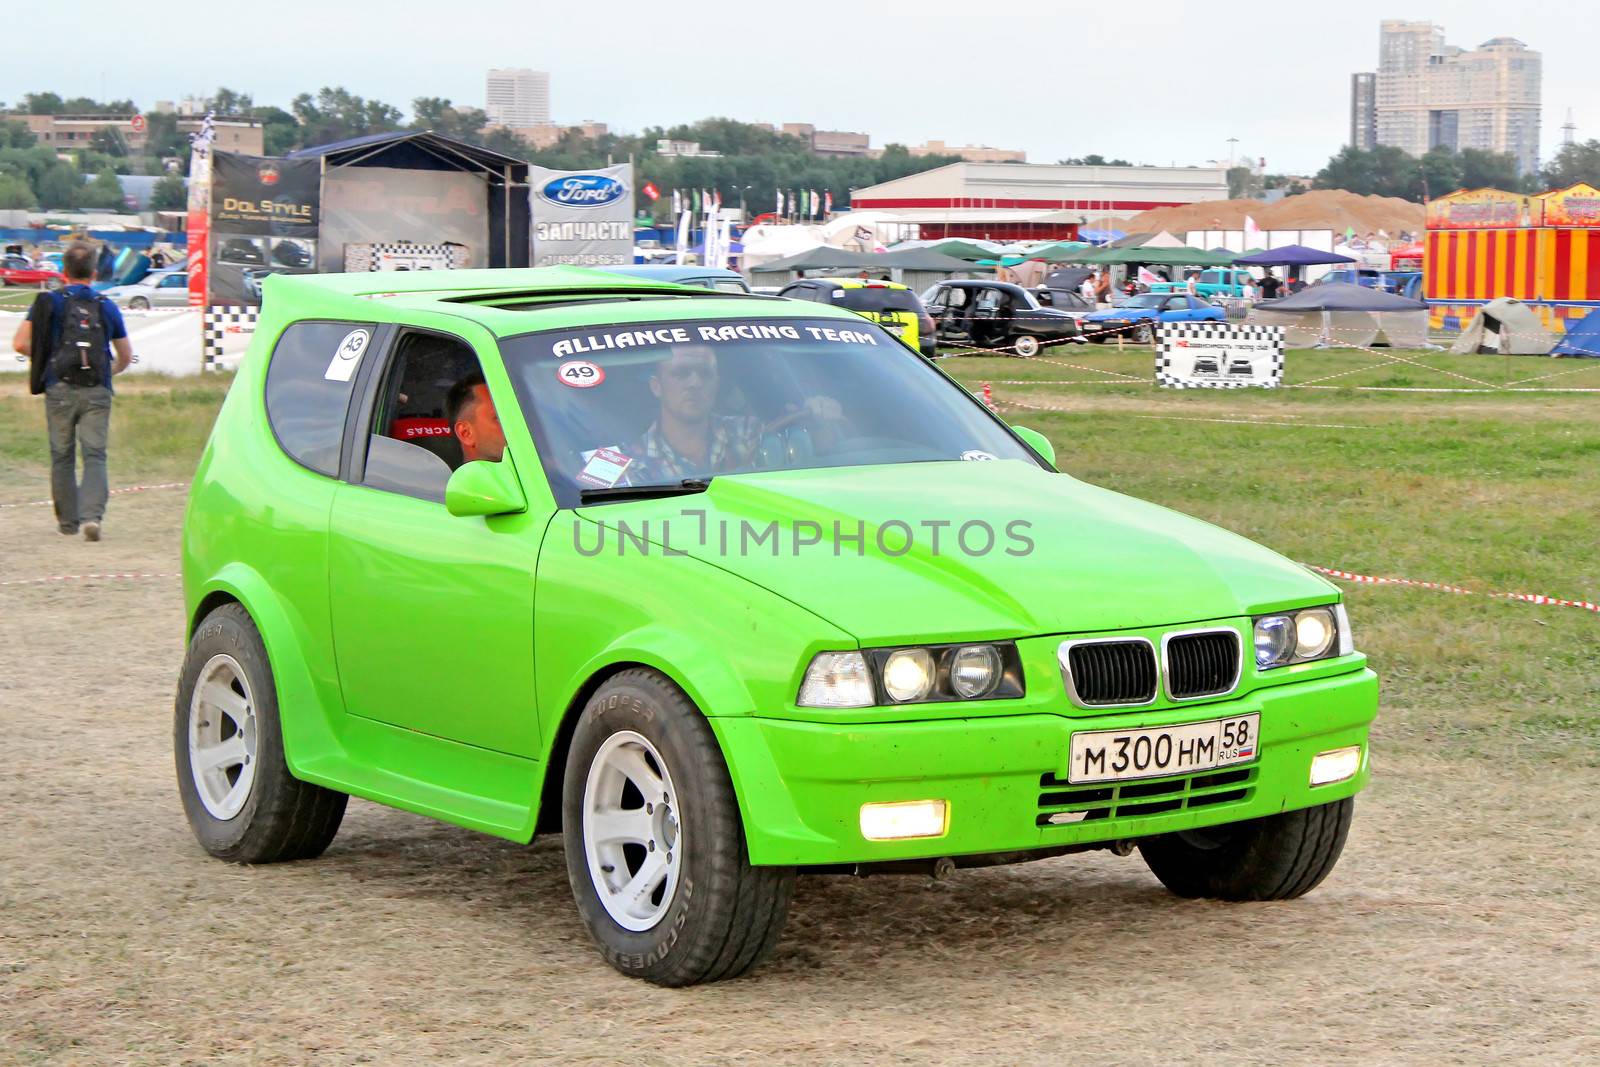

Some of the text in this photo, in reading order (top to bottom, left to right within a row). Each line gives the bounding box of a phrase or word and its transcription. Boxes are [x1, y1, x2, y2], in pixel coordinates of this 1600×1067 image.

[557, 178, 621, 201] Ford
[535, 221, 630, 241] ЗАПЧАСТИ
[552, 325, 878, 358] ALLIANCE RACING TEAM
[565, 366, 595, 378] 49
[1222, 720, 1249, 748] 58
[1219, 750, 1238, 761] RUS
